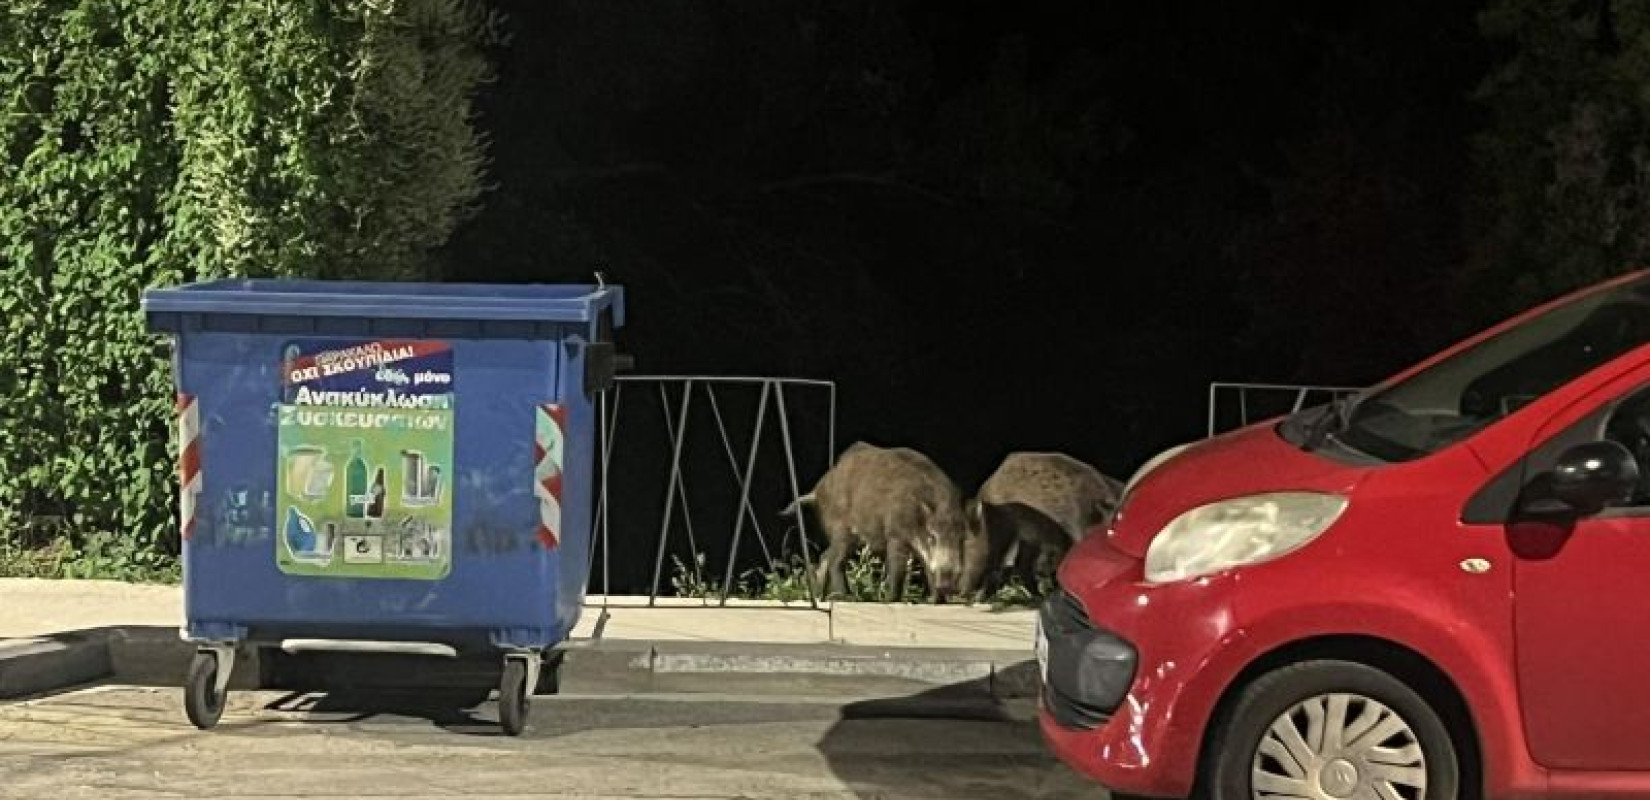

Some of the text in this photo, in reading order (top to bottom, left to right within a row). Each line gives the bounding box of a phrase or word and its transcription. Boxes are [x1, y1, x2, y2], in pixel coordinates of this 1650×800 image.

[291, 346, 414, 382] ΟΧΙ ΣΚΟΥΠΙΔΙΑ!
[413, 369, 452, 385] μόνο
